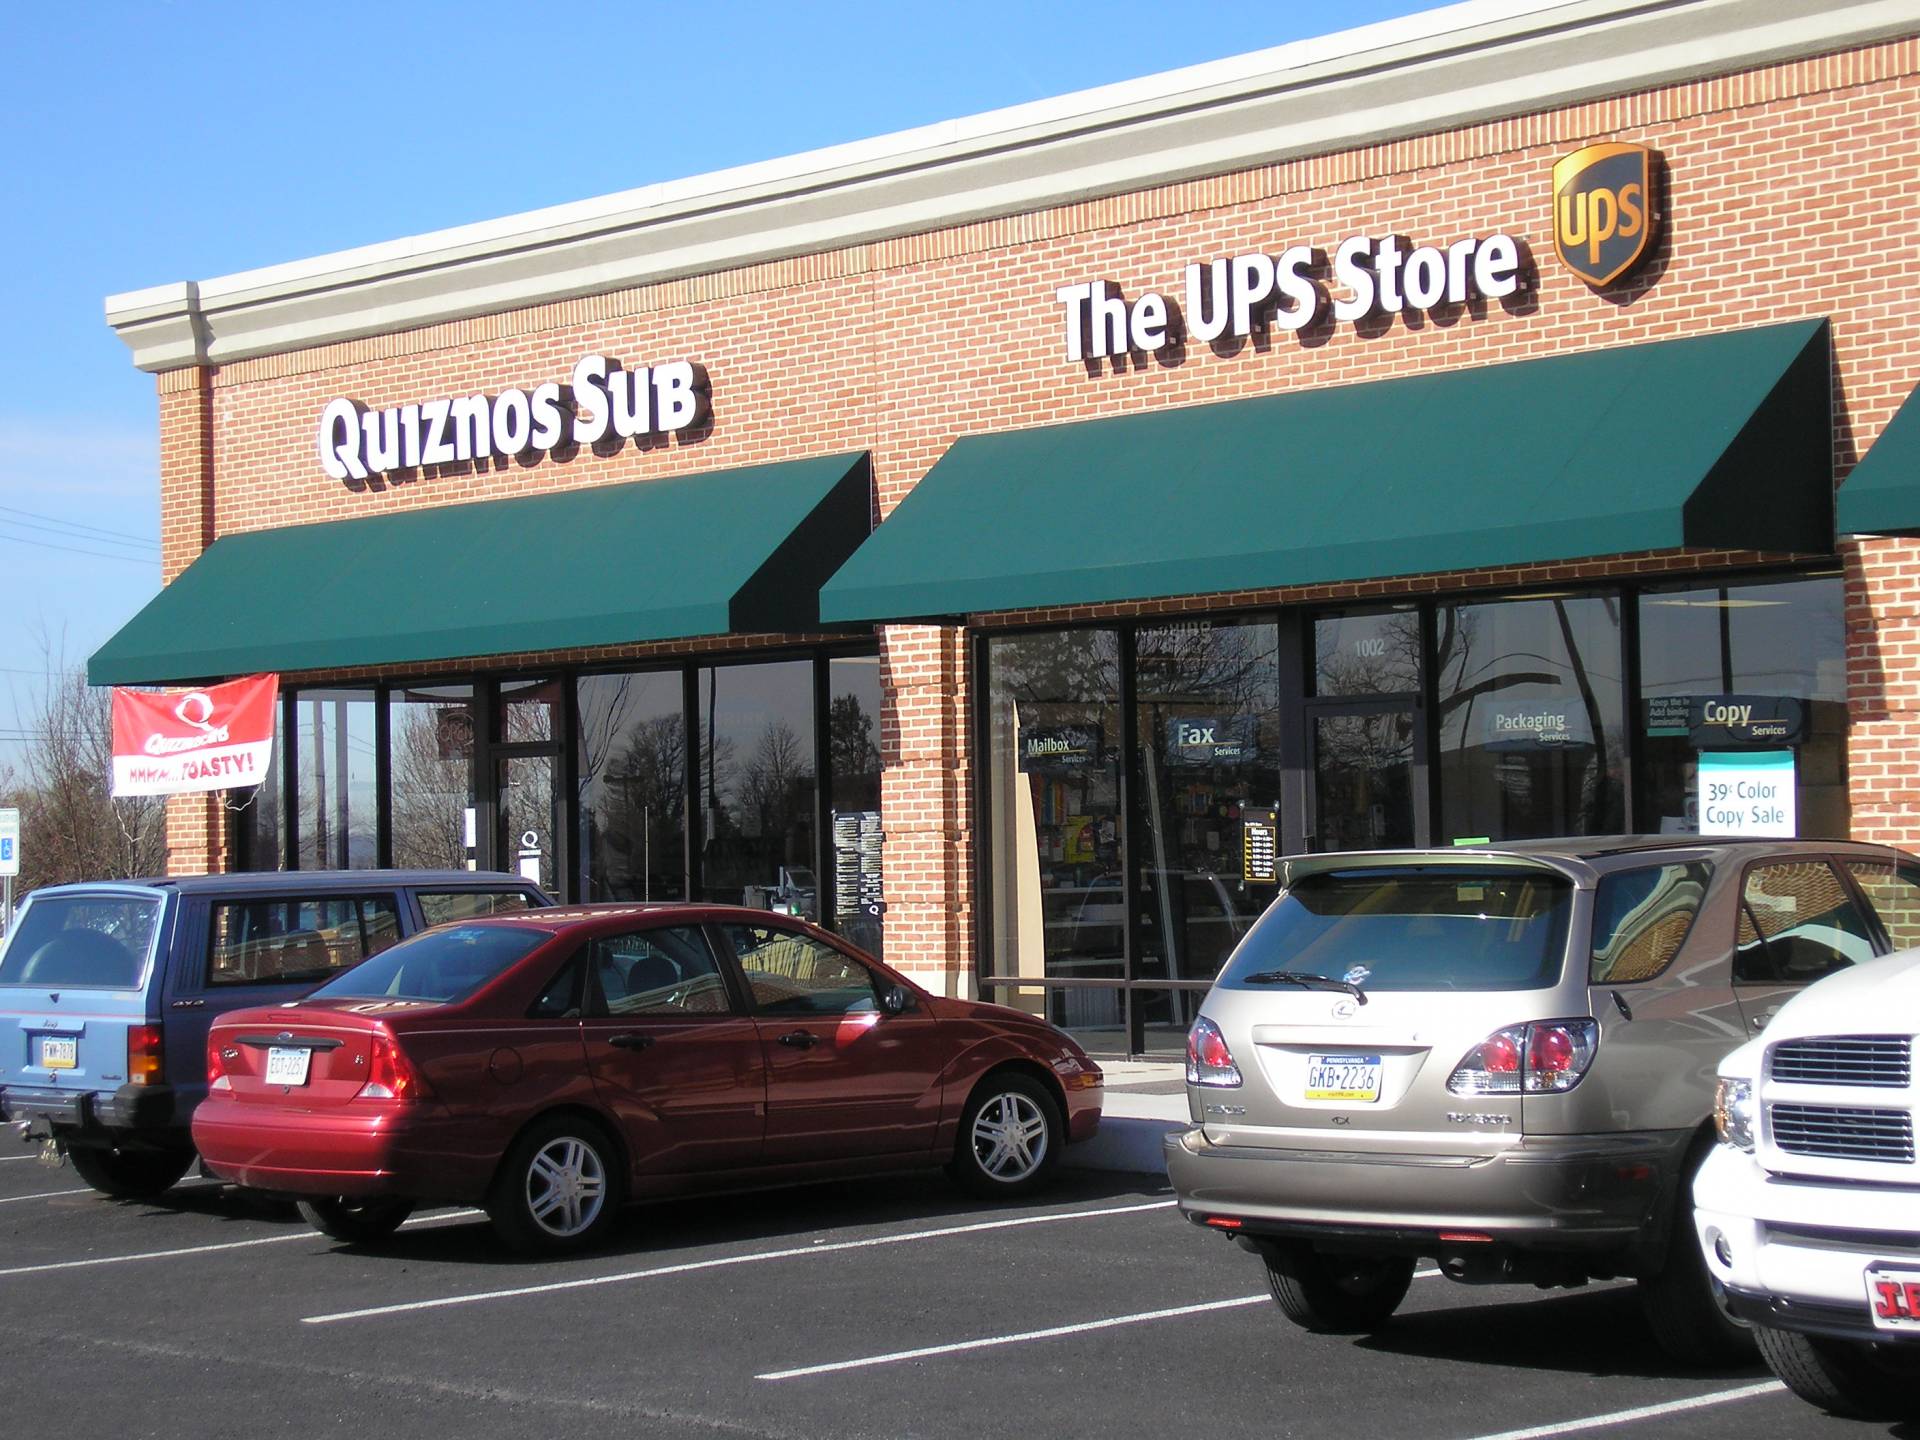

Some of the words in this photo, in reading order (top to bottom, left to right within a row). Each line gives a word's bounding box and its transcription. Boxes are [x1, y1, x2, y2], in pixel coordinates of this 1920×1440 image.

[1562, 184, 1643, 264] ups
[1056, 280, 1166, 362] The
[1185, 246, 1318, 343] UPS
[1334, 234, 1519, 323] Store
[1356, 638, 1385, 657] 1002
[1496, 712, 1565, 732] Packaging
[1704, 701, 1751, 727] Copy
[1178, 724, 1214, 745] Fax
[1539, 732, 1570, 742] Services
[1752, 726, 1787, 736] Services
[1028, 738, 1070, 753] Mailbox
[1214, 746, 1240, 757] Services
[1062, 755, 1086, 764] Services
[1737, 781, 1776, 799] Color
[1706, 806, 1744, 828] Copy
[1751, 805, 1785, 824] Sale
